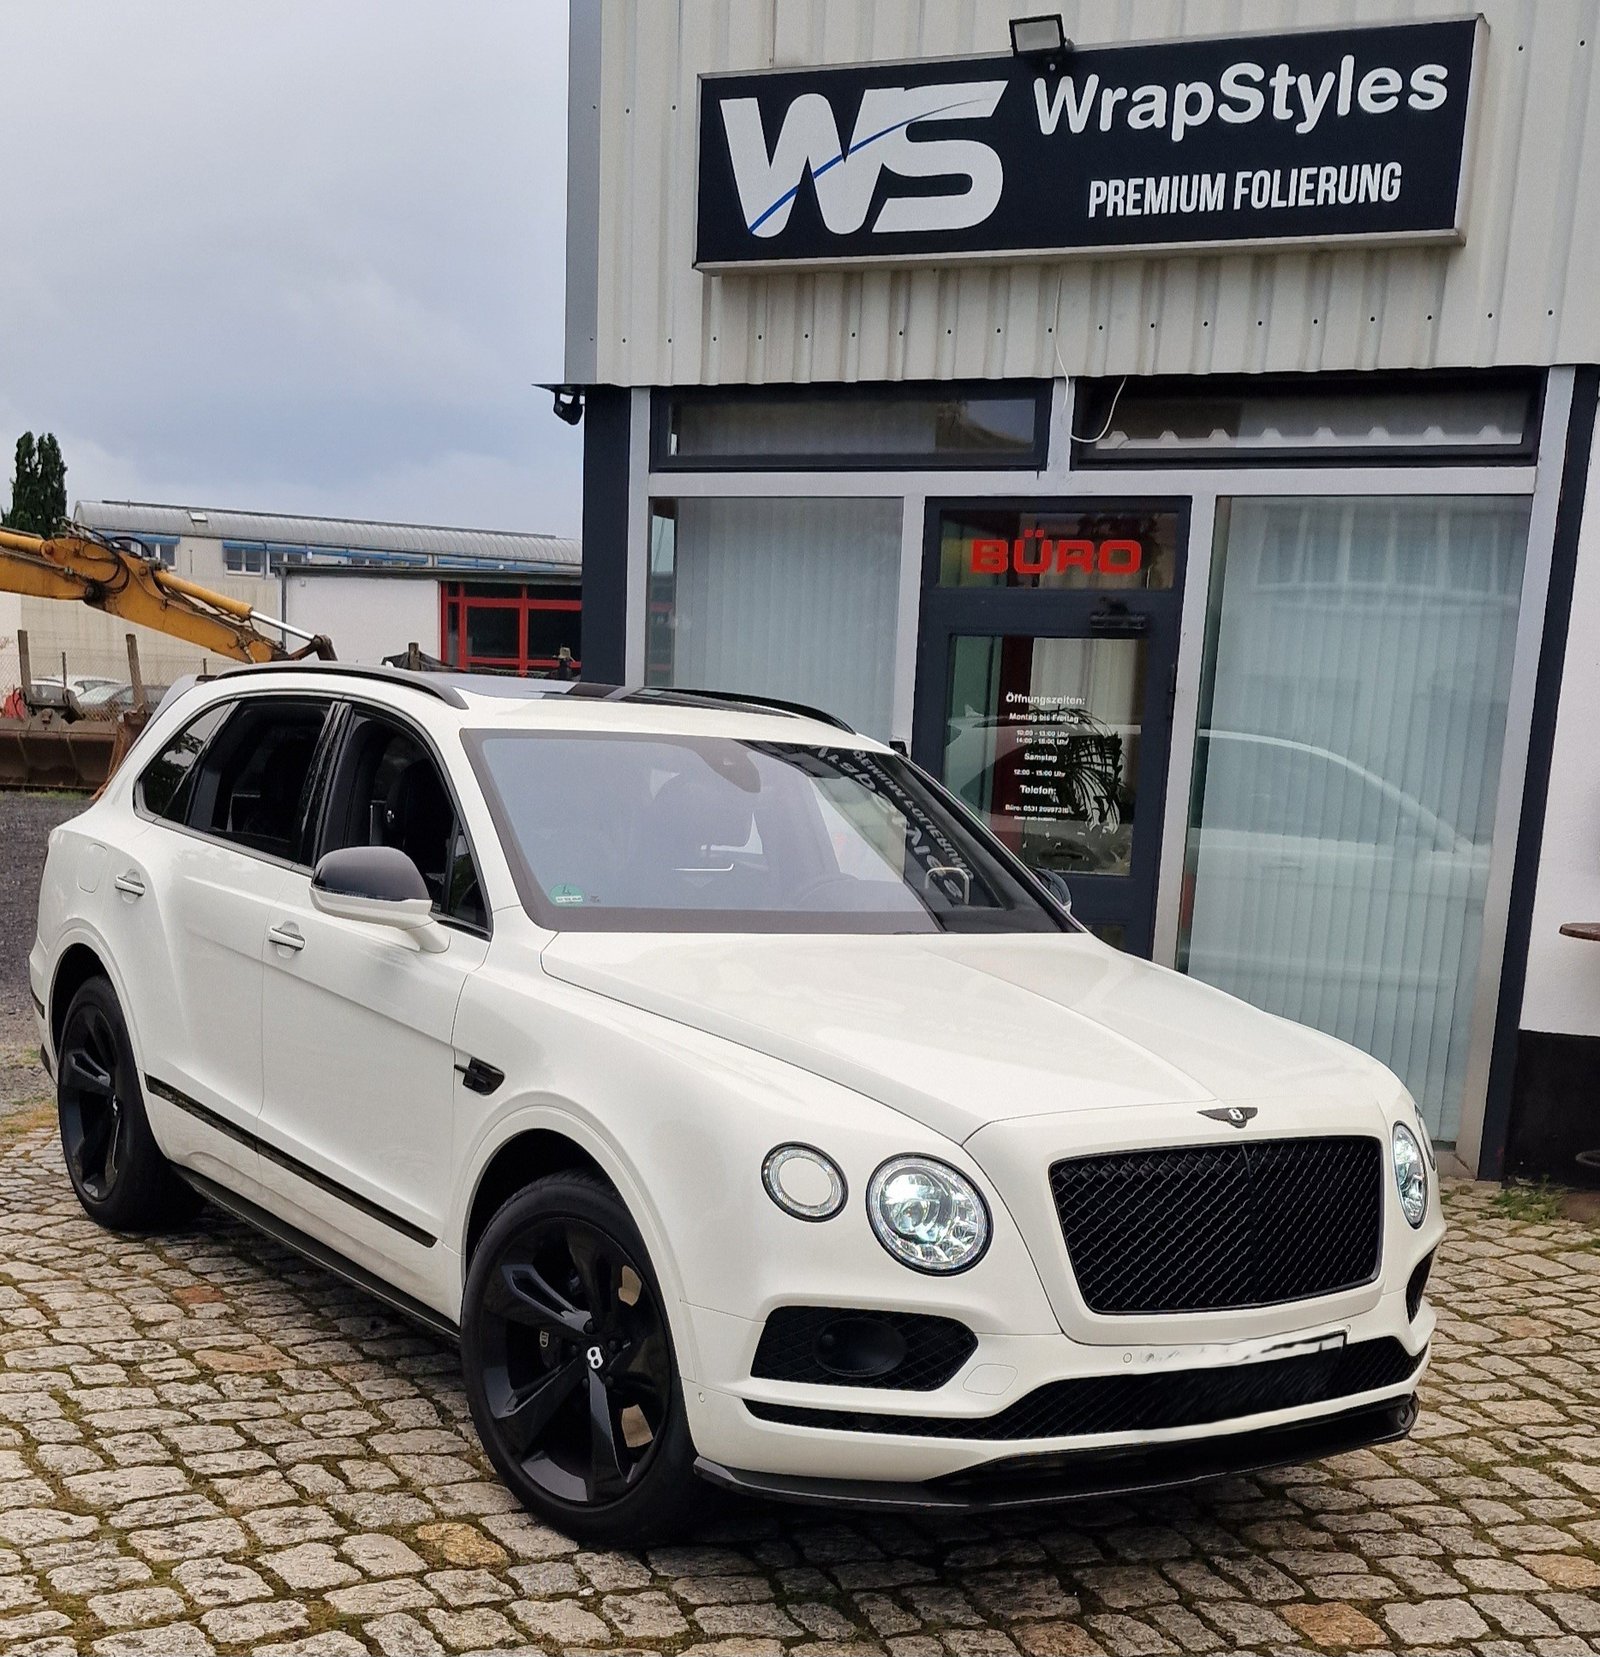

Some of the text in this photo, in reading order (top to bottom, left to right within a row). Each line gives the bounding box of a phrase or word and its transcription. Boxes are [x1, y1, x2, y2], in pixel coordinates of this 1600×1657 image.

[1033, 54, 1448, 142] WrapStyles
[719, 79, 1009, 239] WS
[1088, 161, 1402, 219] PREMIUM FOLIERUNG
[970, 528, 1142, 575] BÜRO
[1005, 691, 1086, 706] Öffnungszeiten:
[1009, 712, 1038, 723] Montag
[1052, 713, 1079, 724] Freitag
[1024, 752, 1058, 763] Samstag
[1020, 784, 1057, 795] Telefon:
